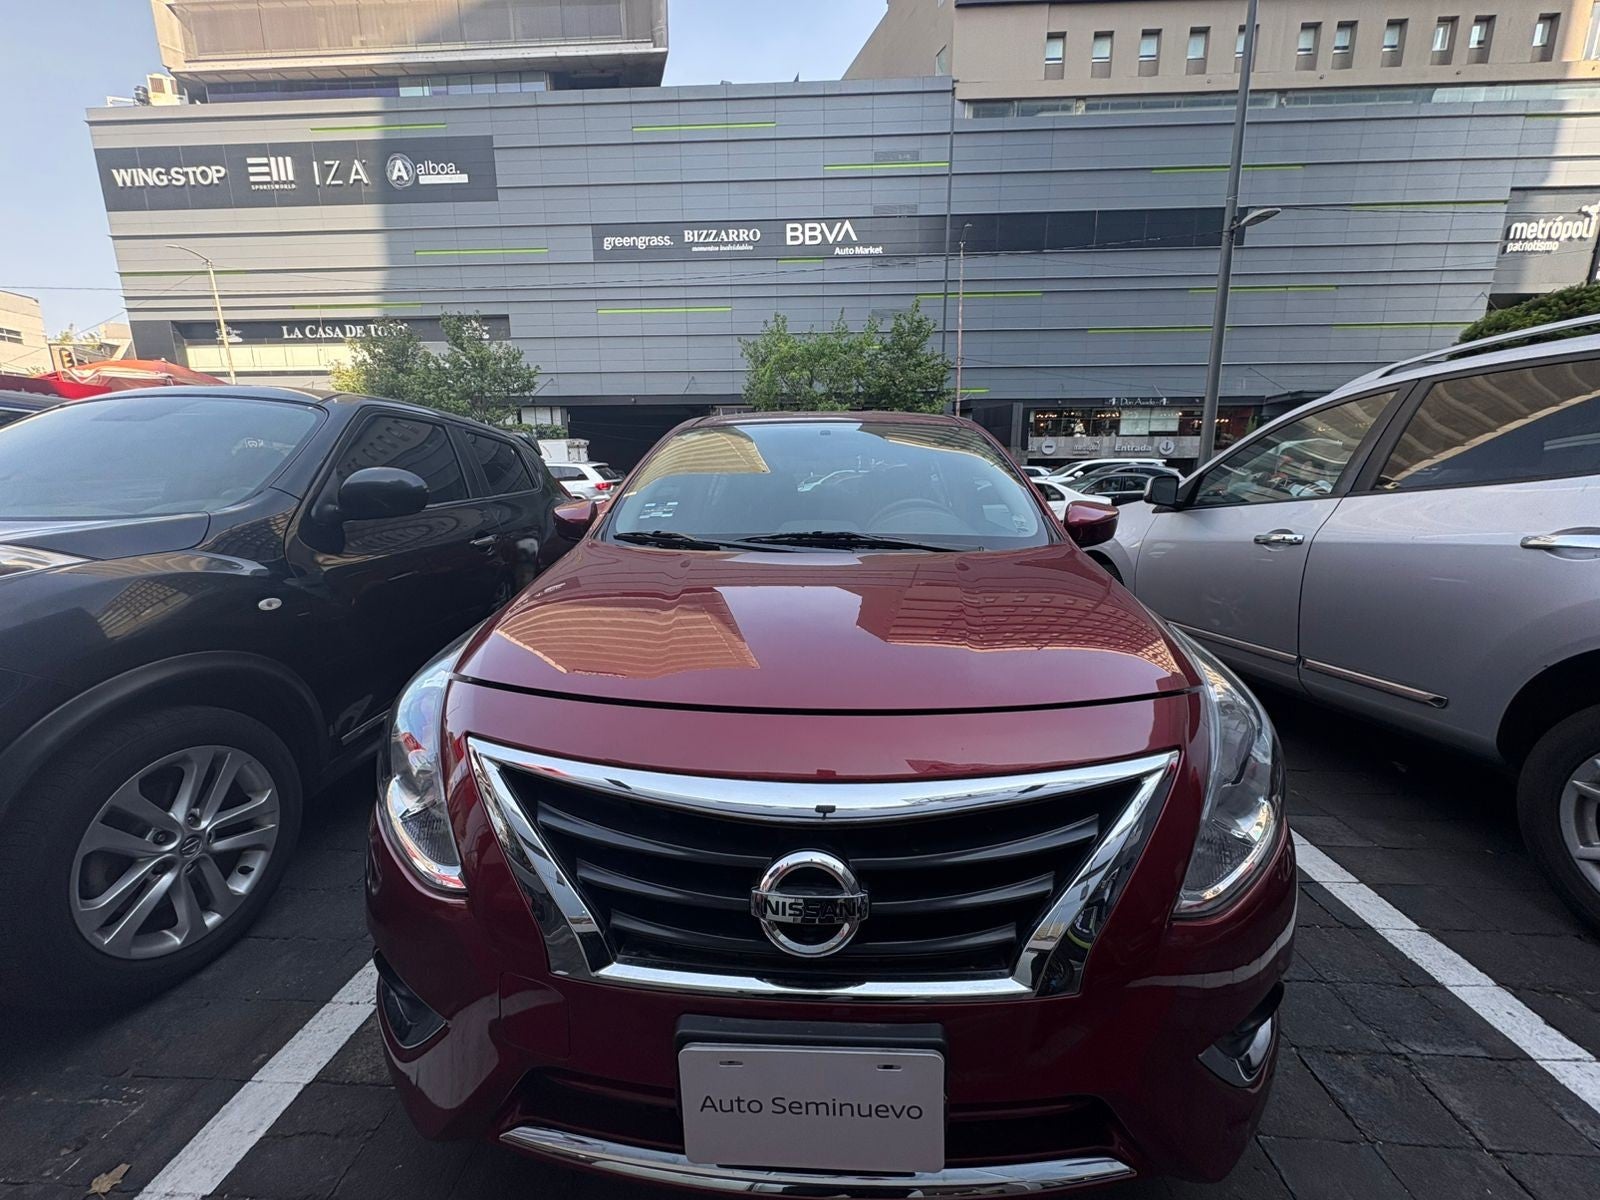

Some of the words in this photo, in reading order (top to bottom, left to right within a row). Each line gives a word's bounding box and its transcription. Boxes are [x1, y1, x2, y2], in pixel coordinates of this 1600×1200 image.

[312, 159, 370, 186] IZA
[683, 228, 761, 243] BIZZARRO
[786, 219, 858, 246] BBVA
[834, 247, 854, 256] Auto
[855, 246, 883, 255] Market
[1506, 240, 1560, 253] patriotismo
[1114, 444, 1152, 453] Entrada
[764, 899, 857, 918] NISSAN
[700, 1095, 763, 1114] Auto
[771, 1097, 924, 1120] Seminuevo
